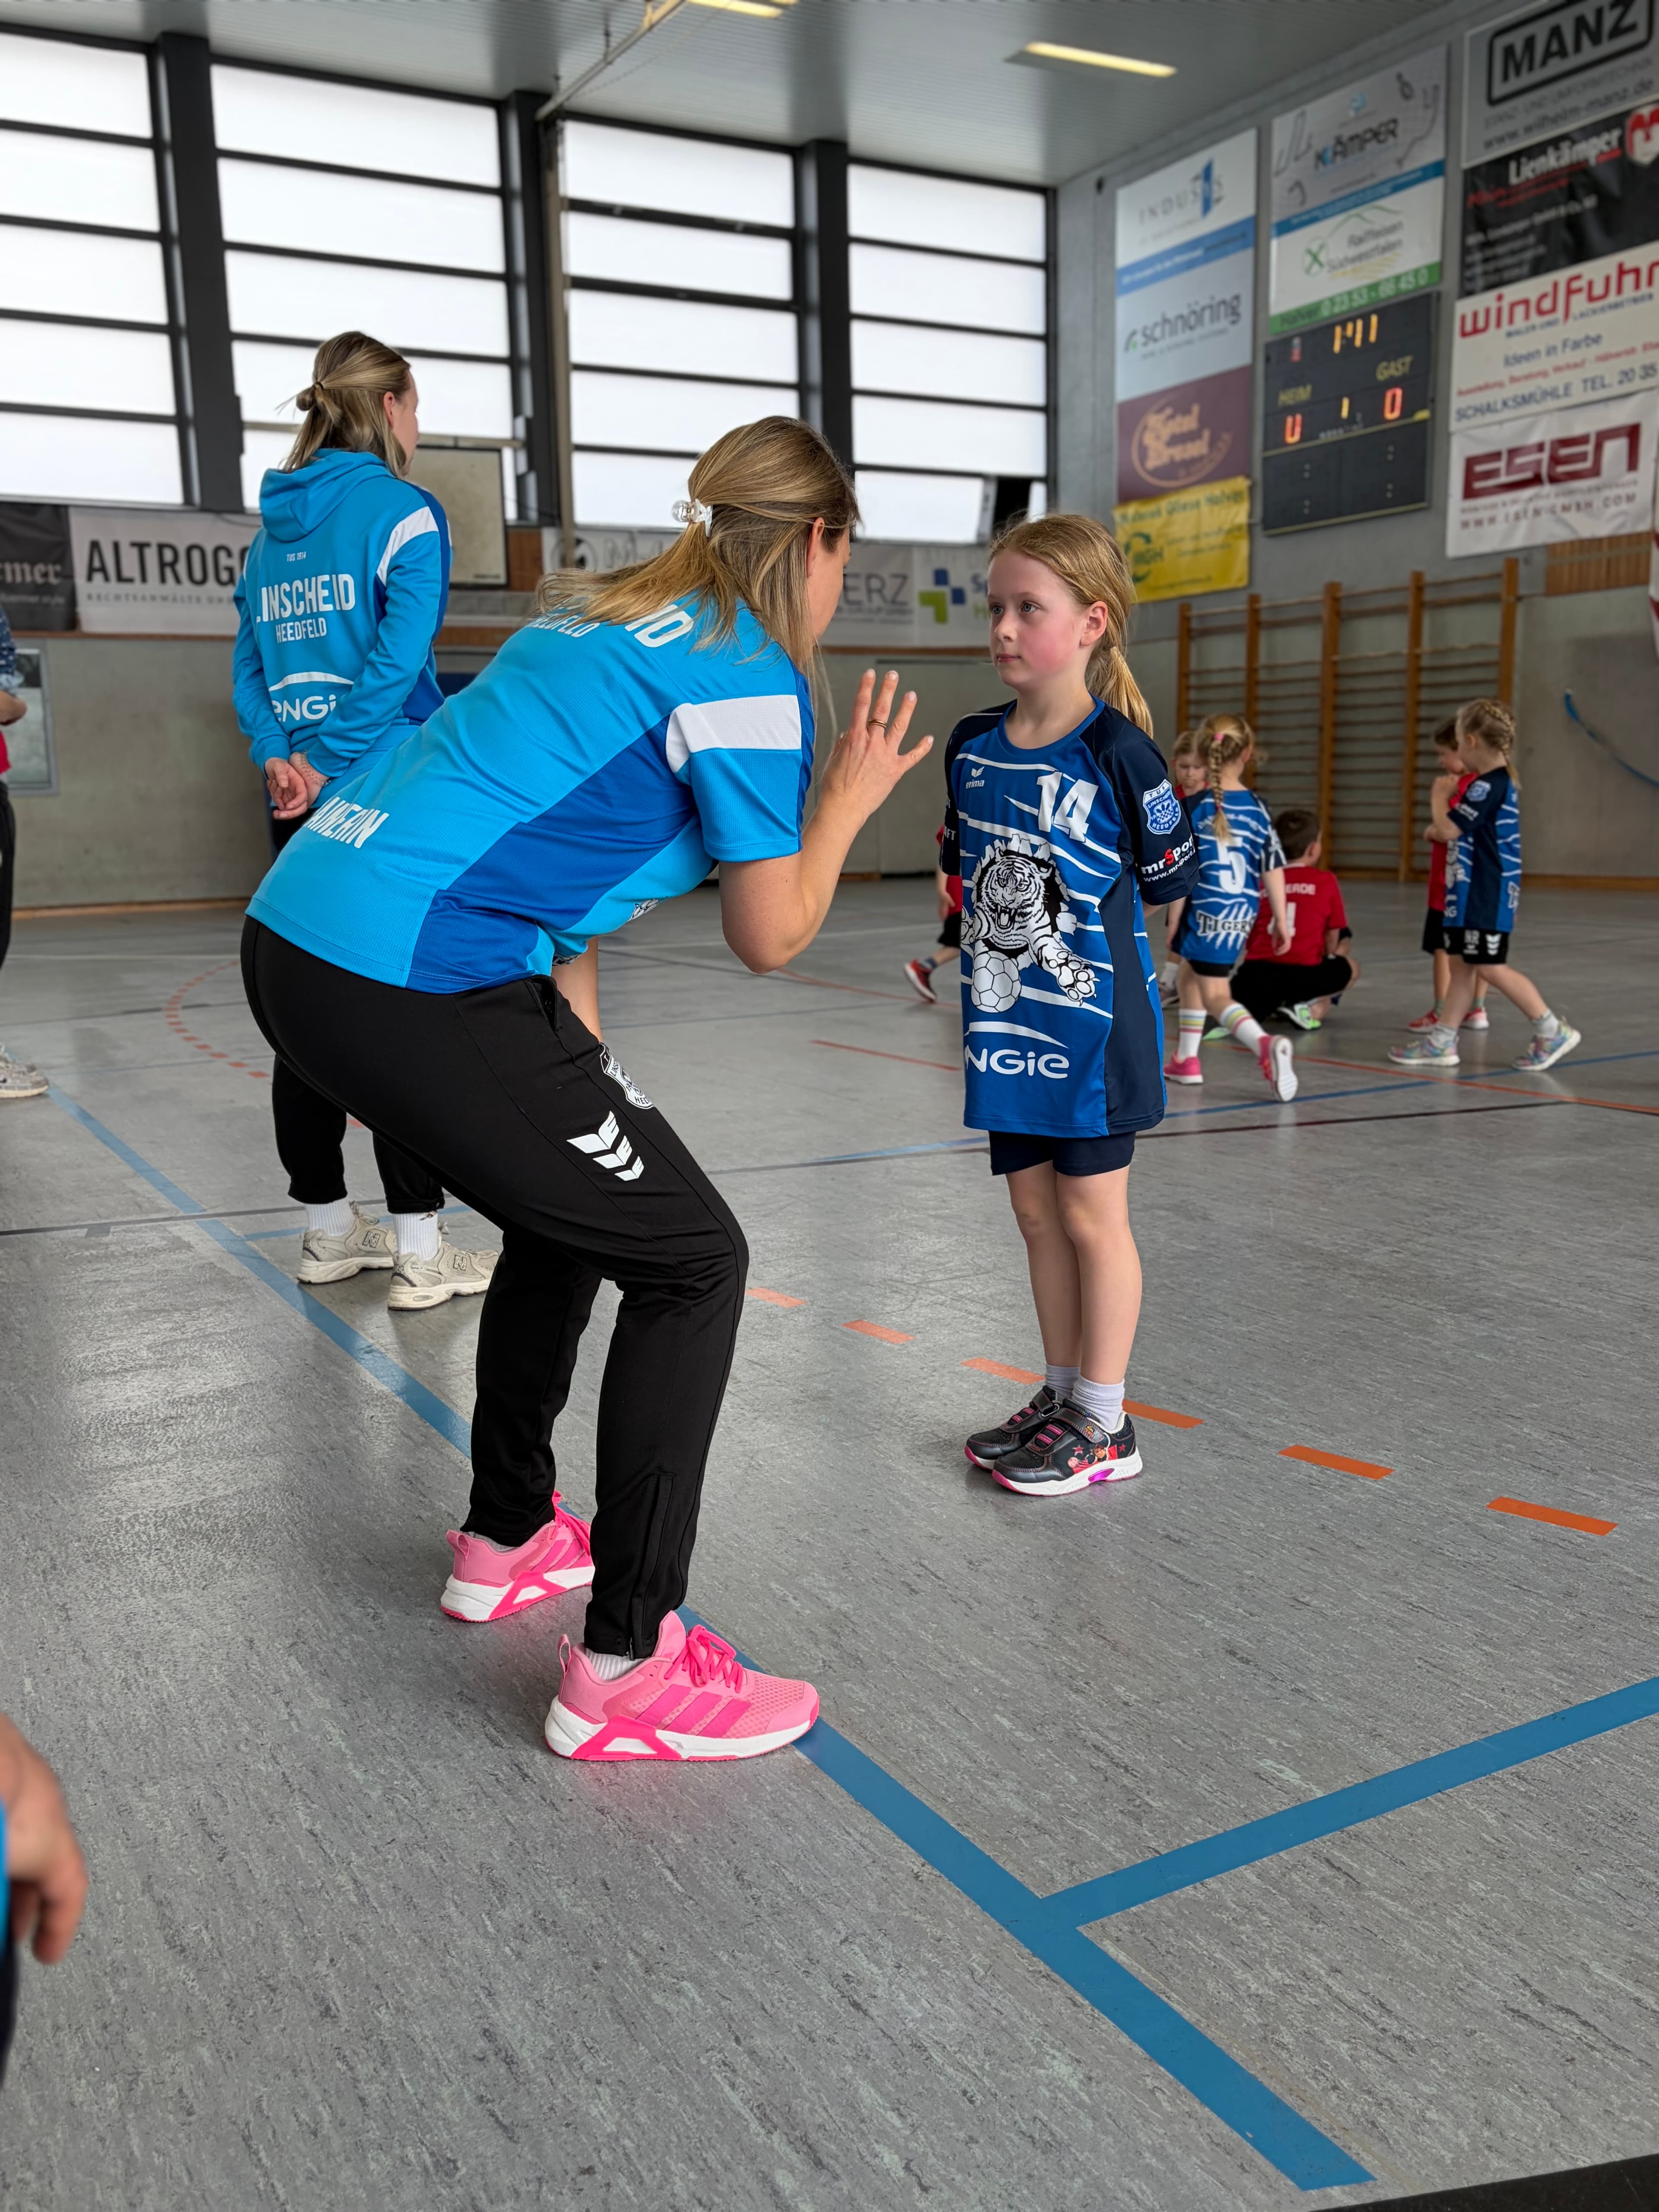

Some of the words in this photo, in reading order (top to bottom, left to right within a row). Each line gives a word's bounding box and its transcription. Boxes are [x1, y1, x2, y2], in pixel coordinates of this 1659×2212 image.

[1503, 0, 1637, 83] MANZ
[1141, 292, 1242, 346] schnöring
[1560, 333, 1603, 354] Farbe
[1376, 354, 1413, 382] GAST
[1278, 383, 1312, 408] HEIM
[1383, 387, 1403, 421] 0
[1455, 381, 1574, 422] SCHALKSMÜHLE
[1580, 374, 1612, 394] TEL.
[1616, 367, 1636, 385] 20
[256, 573, 356, 623] INSCHEID
[276, 617, 327, 643] HEEDFELD
[966, 779, 985, 789] erima
[1149, 785, 1166, 798] TUS
[1036, 771, 1099, 842] 14
[1152, 807, 1179, 830] HEEDFELD
[1141, 834, 1194, 874] mrSpor
[1217, 836, 1246, 894] 5
[362, 1230, 381, 1249] N
[453, 1254, 467, 1271] N
